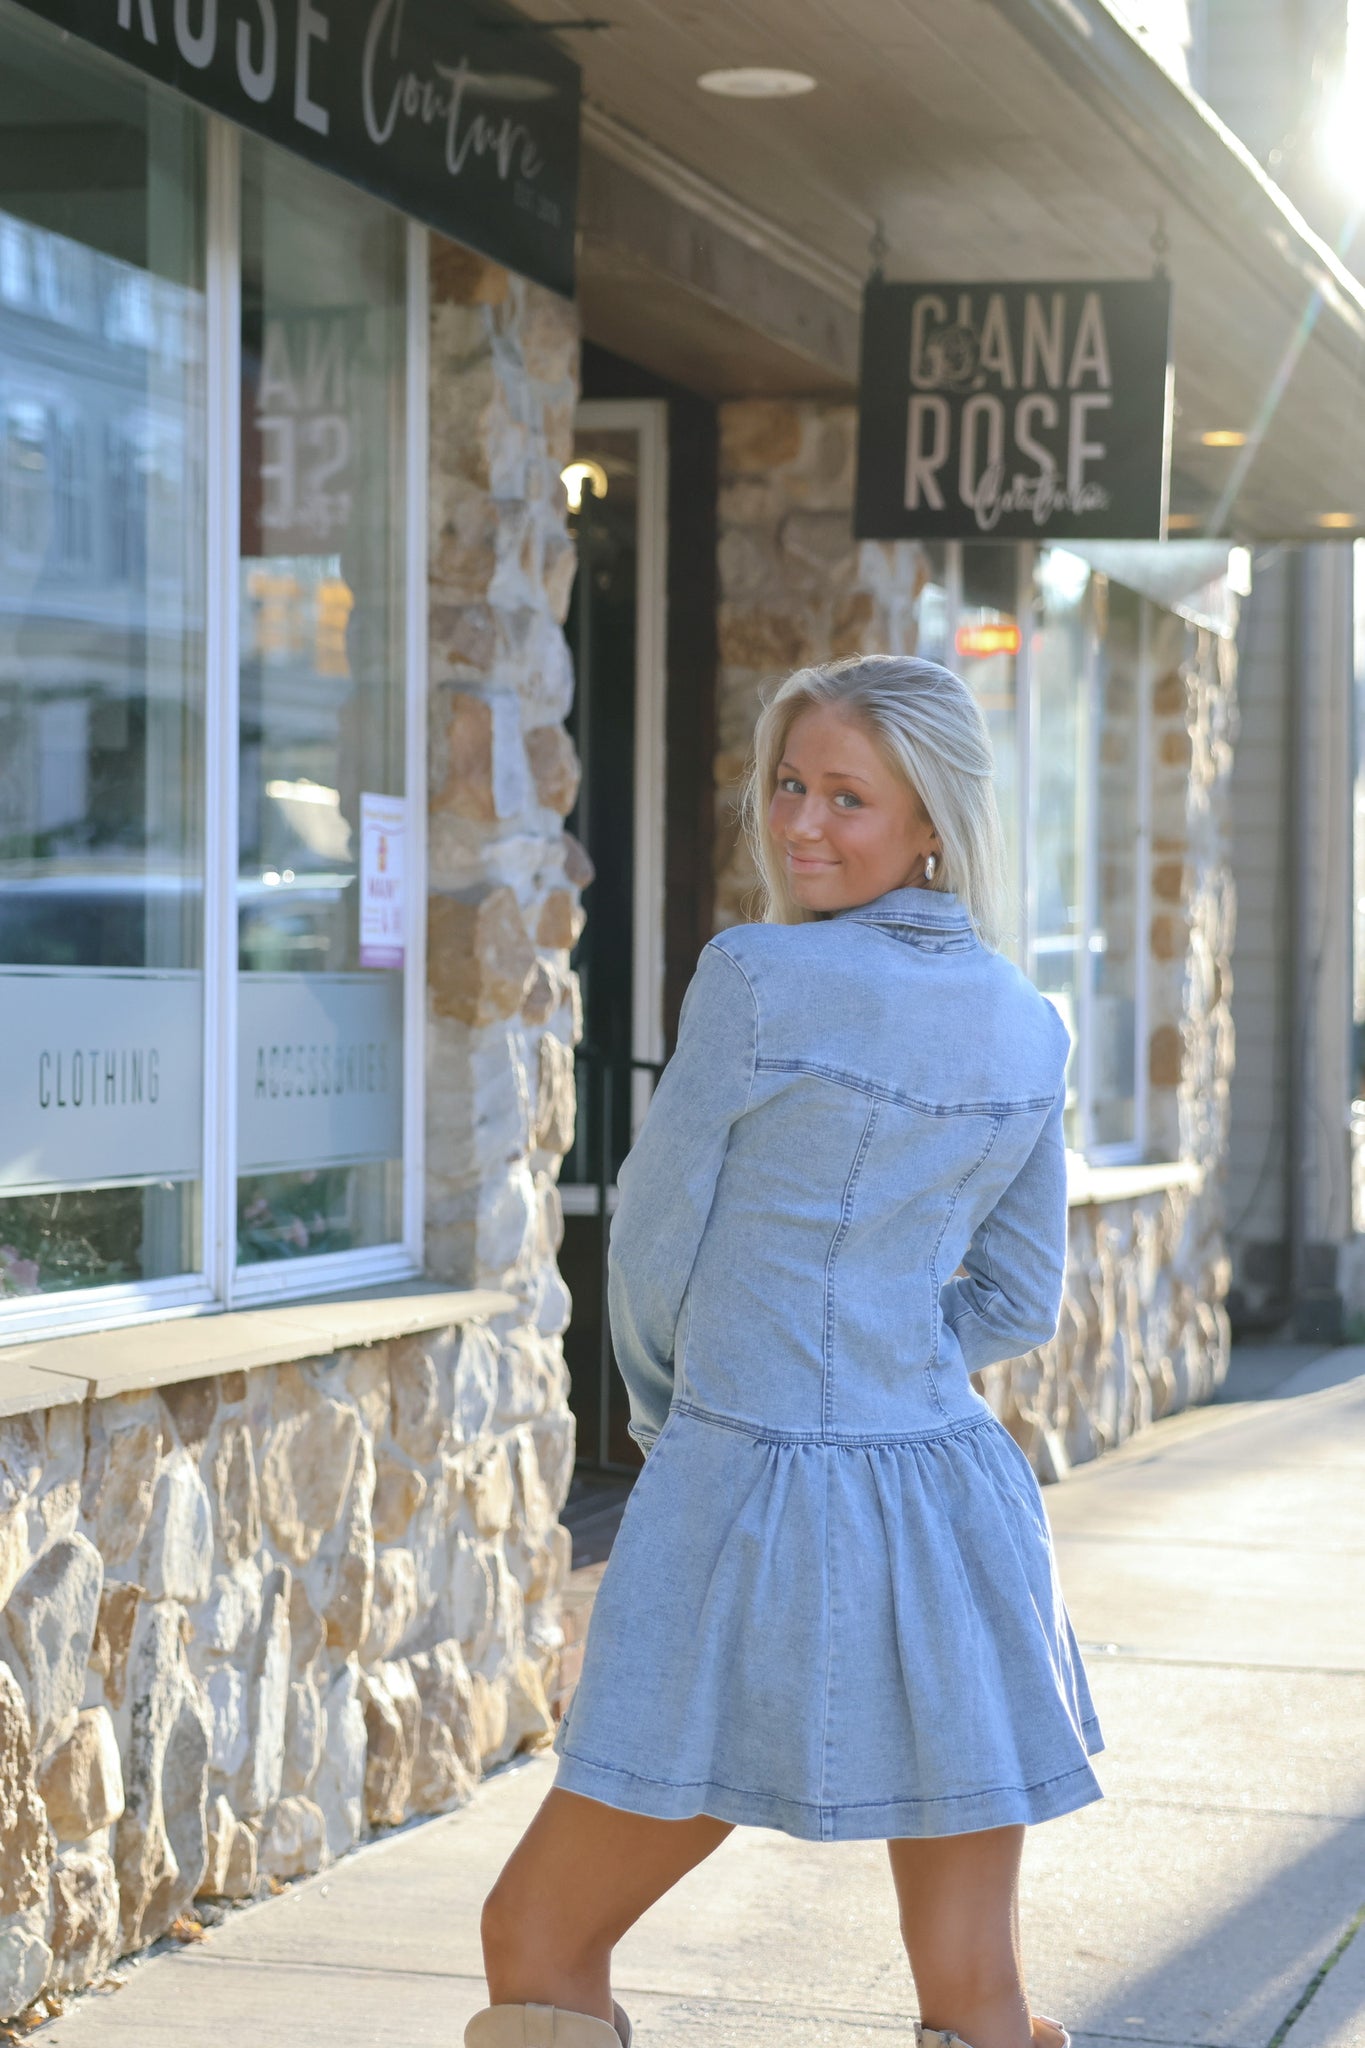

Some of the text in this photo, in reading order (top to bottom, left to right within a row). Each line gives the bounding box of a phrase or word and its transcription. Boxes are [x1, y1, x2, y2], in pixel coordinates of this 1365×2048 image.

[117, 0, 558, 181] SE Couture
[904, 393, 1113, 511] ROSE
[38, 1048, 160, 1109] CLOTHING
[254, 1042, 389, 1099] ACCESSORIES
